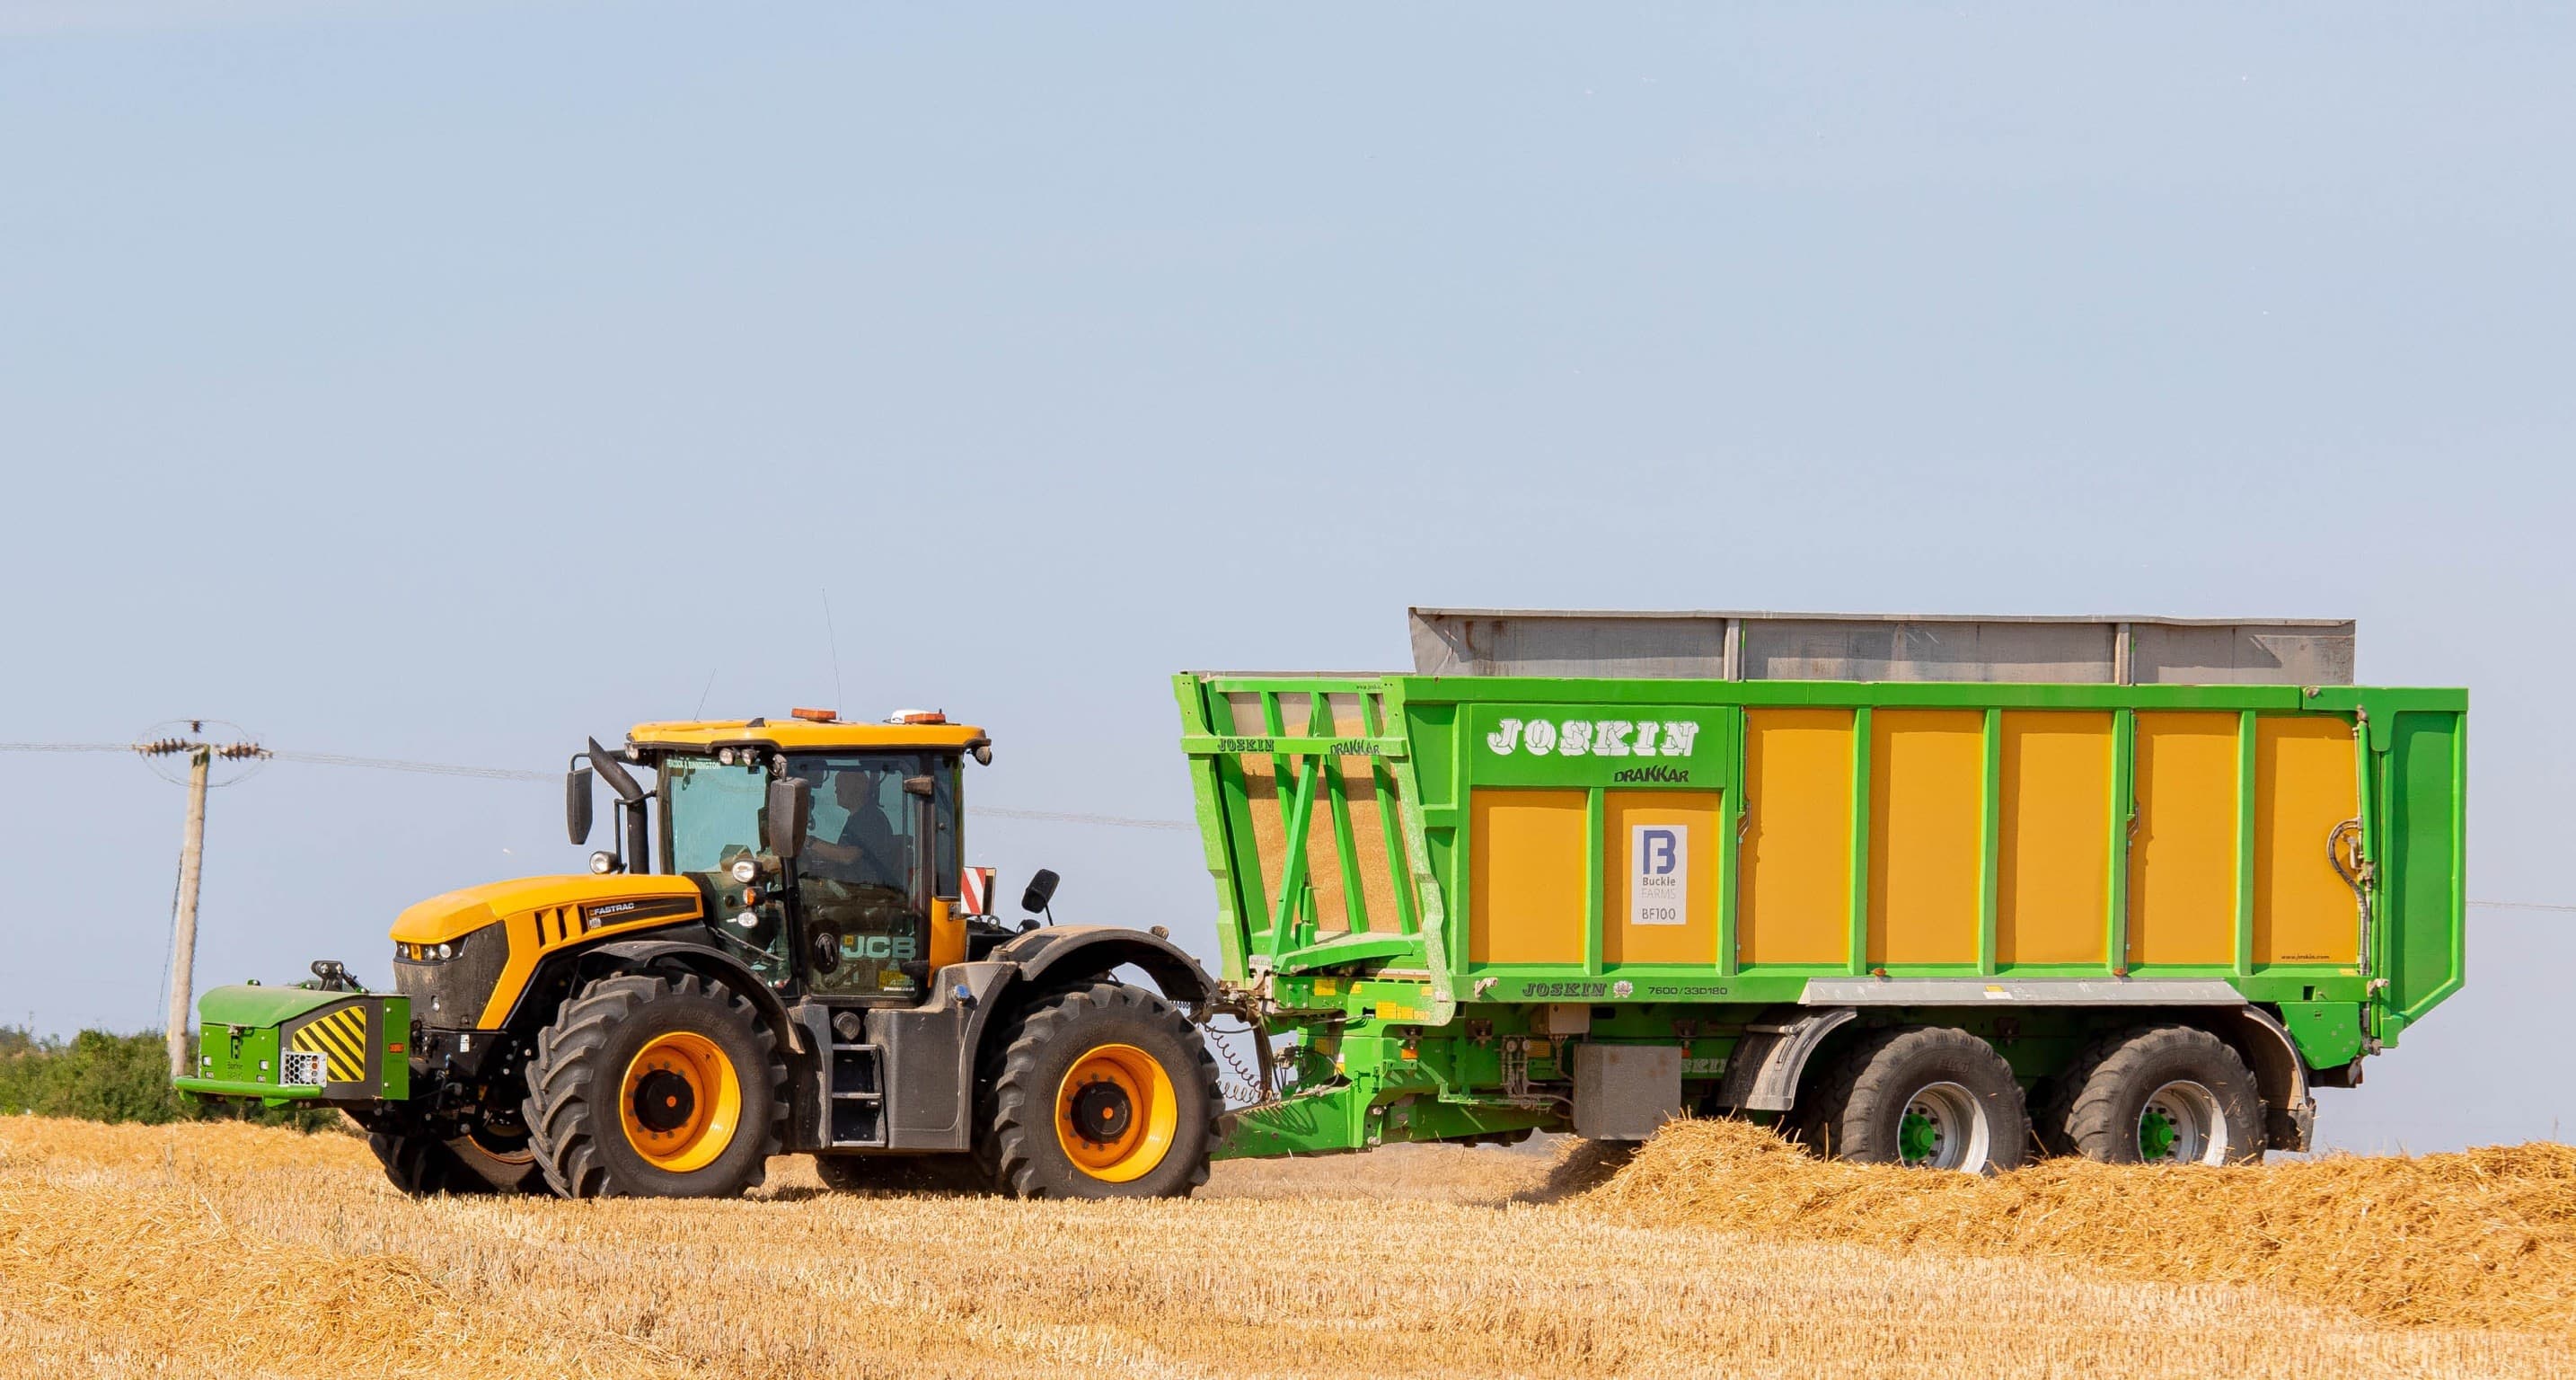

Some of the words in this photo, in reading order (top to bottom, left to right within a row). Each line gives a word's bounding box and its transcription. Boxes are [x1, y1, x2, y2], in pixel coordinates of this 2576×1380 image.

[1486, 719, 1699, 756] JOSKIN
[1217, 739, 1275, 752] JOSKIN
[1329, 739, 1380, 755] DRAKKAR
[1614, 765, 1689, 783] DRAKKAR
[1643, 877, 1676, 886] Buckle
[1642, 889, 1675, 899] FARMS
[595, 903, 635, 916] FASTRAC
[1642, 908, 1676, 920] BF100
[842, 935, 916, 959] JCB
[1522, 983, 1607, 997] JOSKIN
